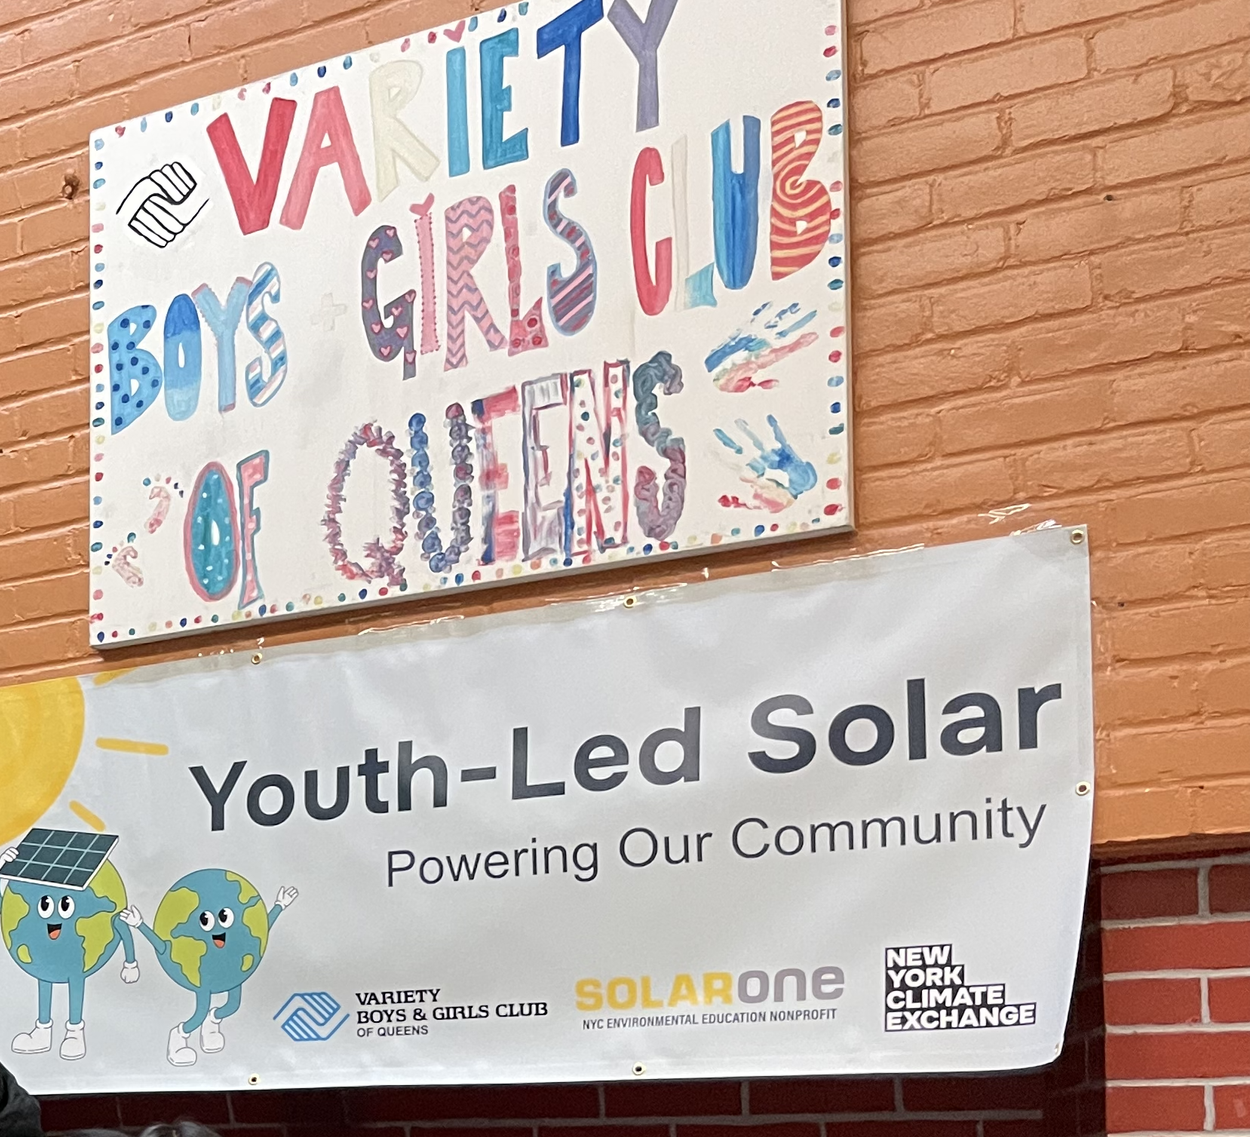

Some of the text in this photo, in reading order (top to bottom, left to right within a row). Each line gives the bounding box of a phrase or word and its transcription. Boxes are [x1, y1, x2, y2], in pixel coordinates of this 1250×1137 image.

[206, 0, 674, 236] VARIETY
[106, 262, 287, 436] BOYS
[361, 167, 598, 381] GIRLS
[630, 100, 832, 316] CLUB
[184, 351, 687, 610] OF QUEENS
[189, 677, 1062, 832] Youth-Led Solar
[387, 796, 1047, 887] Powering Our Community
[886, 945, 950, 968] NEW
[887, 965, 963, 988] YORK
[355, 988, 441, 1006] VARIETY
[886, 985, 1004, 1010] CLIMATE
[356, 1002, 549, 1024] BOYS & GIRLS CLUB
[582, 1008, 838, 1030] NYC ENVIRONMENTAL EDUCATION NONPROFIT
[886, 1004, 1035, 1031] EXCHANGE
[356, 1025, 429, 1038] OF QUEENS
